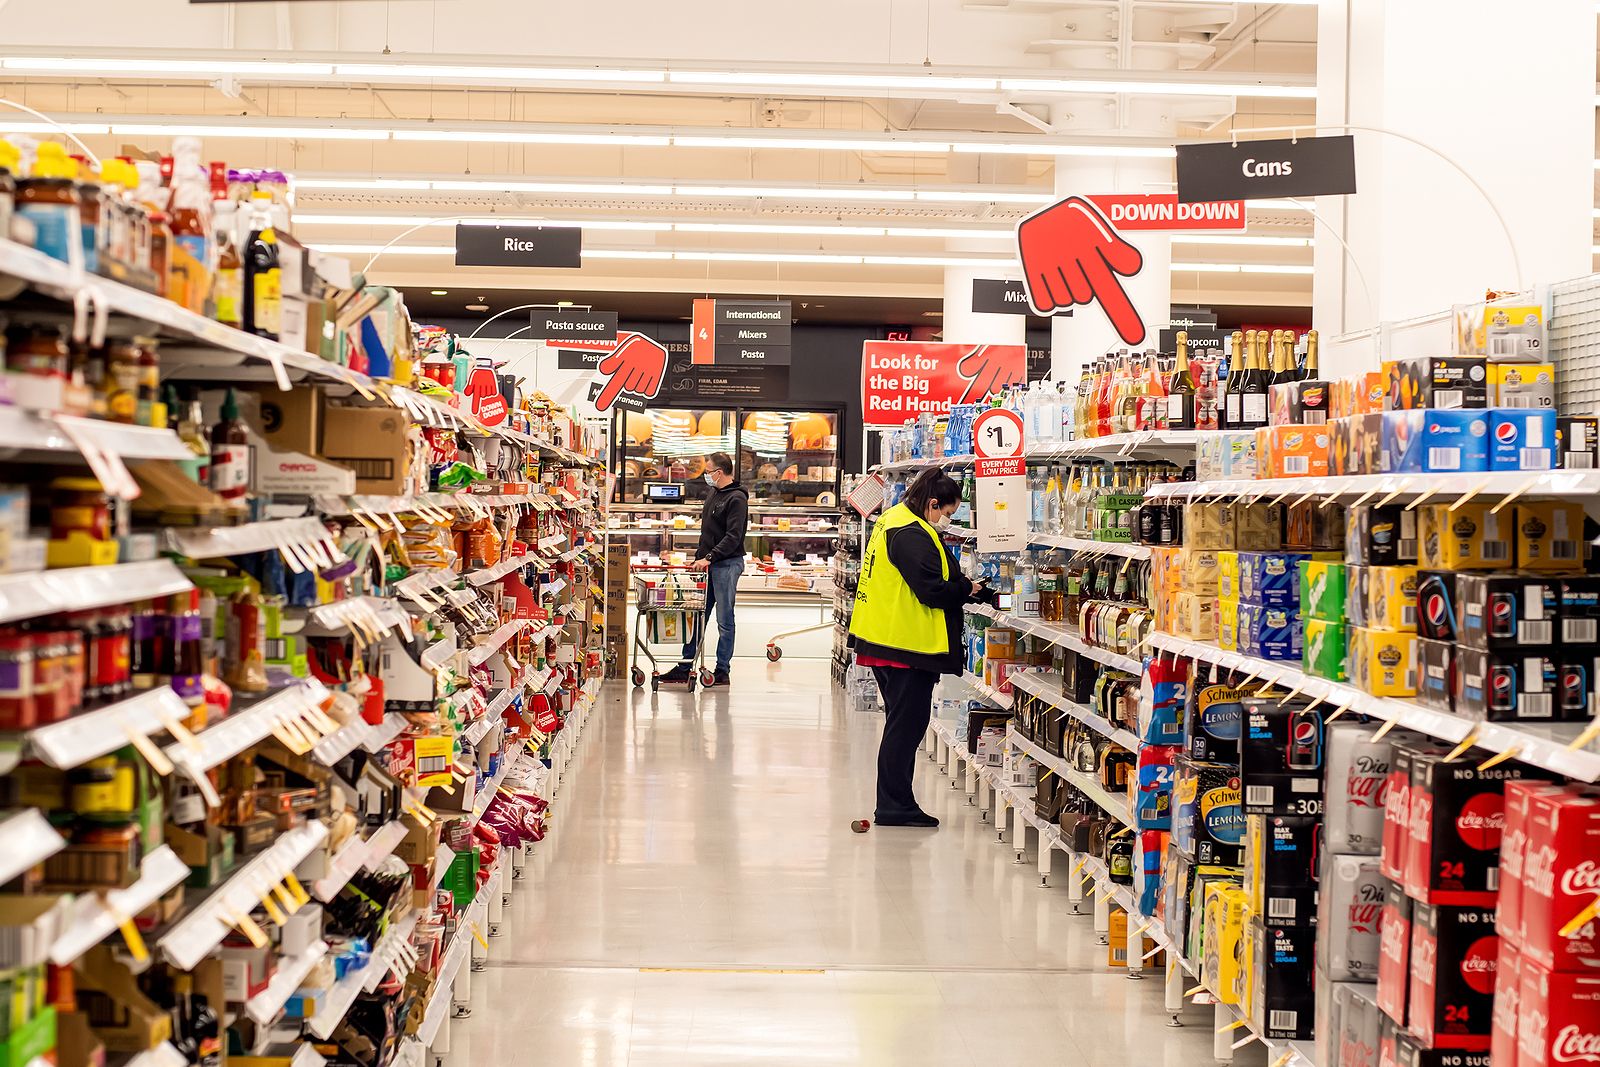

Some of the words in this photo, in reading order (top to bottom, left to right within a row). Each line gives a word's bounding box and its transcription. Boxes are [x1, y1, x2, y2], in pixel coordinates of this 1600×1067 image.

[1242, 158, 1292, 177] Cans
[1110, 204, 1173, 221] DOWN
[1177, 202, 1239, 220] DOWN
[504, 238, 534, 251] Rice
[1004, 291, 1027, 302] Mix
[726, 310, 781, 320] International
[546, 320, 574, 331] Pasta
[576, 323, 605, 331] sauce
[1170, 317, 1194, 326] nacks
[699, 328, 708, 340] 4
[738, 330, 767, 339] Mixers
[1187, 339, 1219, 348] opcorn
[1527, 339, 1540, 348] 10
[741, 350, 765, 359] Pasta
[870, 354, 911, 370] Look
[914, 354, 939, 370] for
[870, 374, 899, 390] the
[902, 375, 929, 394] Big
[481, 401, 502, 412] DOWN
[870, 395, 902, 411] Red
[906, 396, 951, 412] Hand
[1538, 397, 1551, 406] 10
[483, 407, 504, 418] DOWN
[987, 426, 1003, 447] $1
[981, 460, 1004, 468] EVERY
[1004, 459, 1019, 467] DAY
[983, 467, 1000, 475] LOW
[1000, 466, 1018, 474] PRICE
[1173, 683, 1185, 699] 2
[1195, 740, 1205, 748] 30
[1454, 769, 1474, 779] NO
[1478, 769, 1521, 779] SUGAR
[1297, 800, 1317, 815] 30
[1348, 834, 1362, 843] 30
[1201, 844, 1211, 853] 24
[1440, 861, 1465, 878] 24
[1458, 912, 1478, 923] NO
[1348, 960, 1362, 969] 30
[1444, 1004, 1470, 1021] 24
[1442, 1056, 1461, 1066] NO
